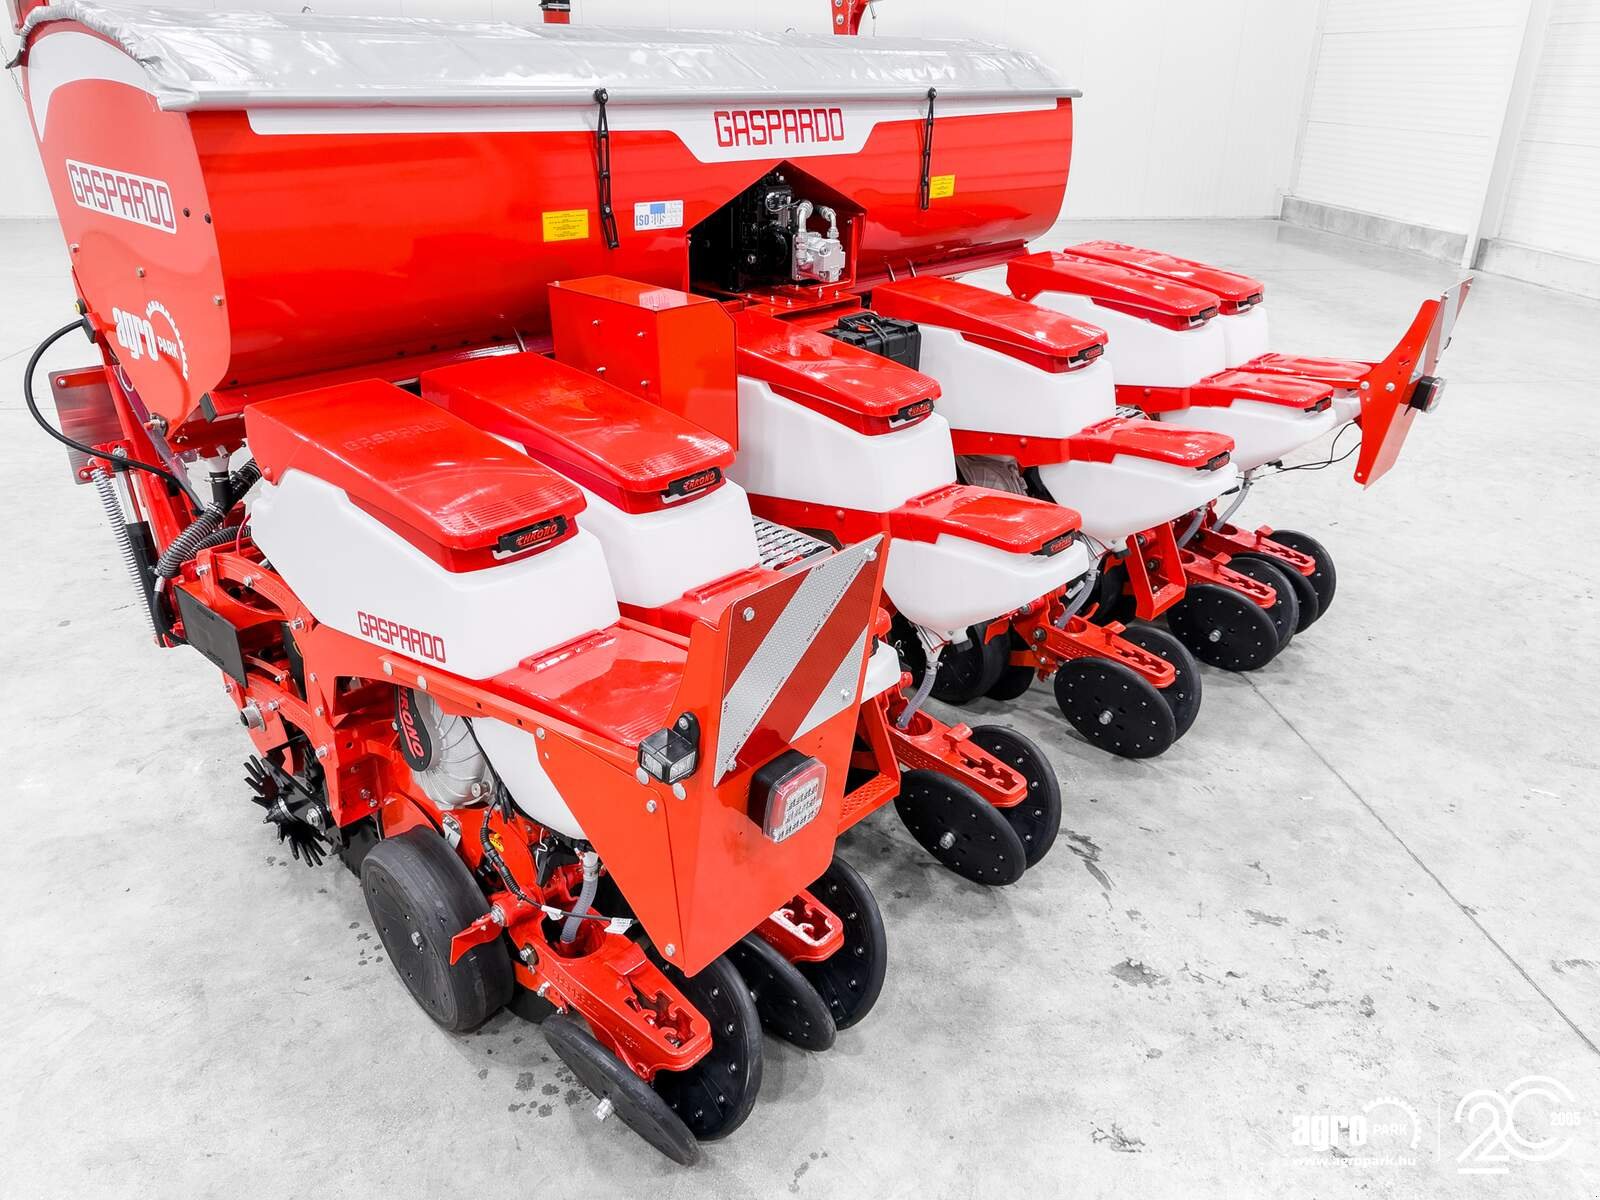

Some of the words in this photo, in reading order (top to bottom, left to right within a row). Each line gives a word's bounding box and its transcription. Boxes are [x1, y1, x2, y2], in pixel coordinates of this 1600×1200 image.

[714, 108, 844, 147] GASPARDO
[68, 164, 174, 229] GASPARDO
[112, 307, 159, 361] agro
[157, 336, 179, 359] PARK
[516, 524, 558, 546] CHRONO
[357, 611, 446, 663] GASPARDO
